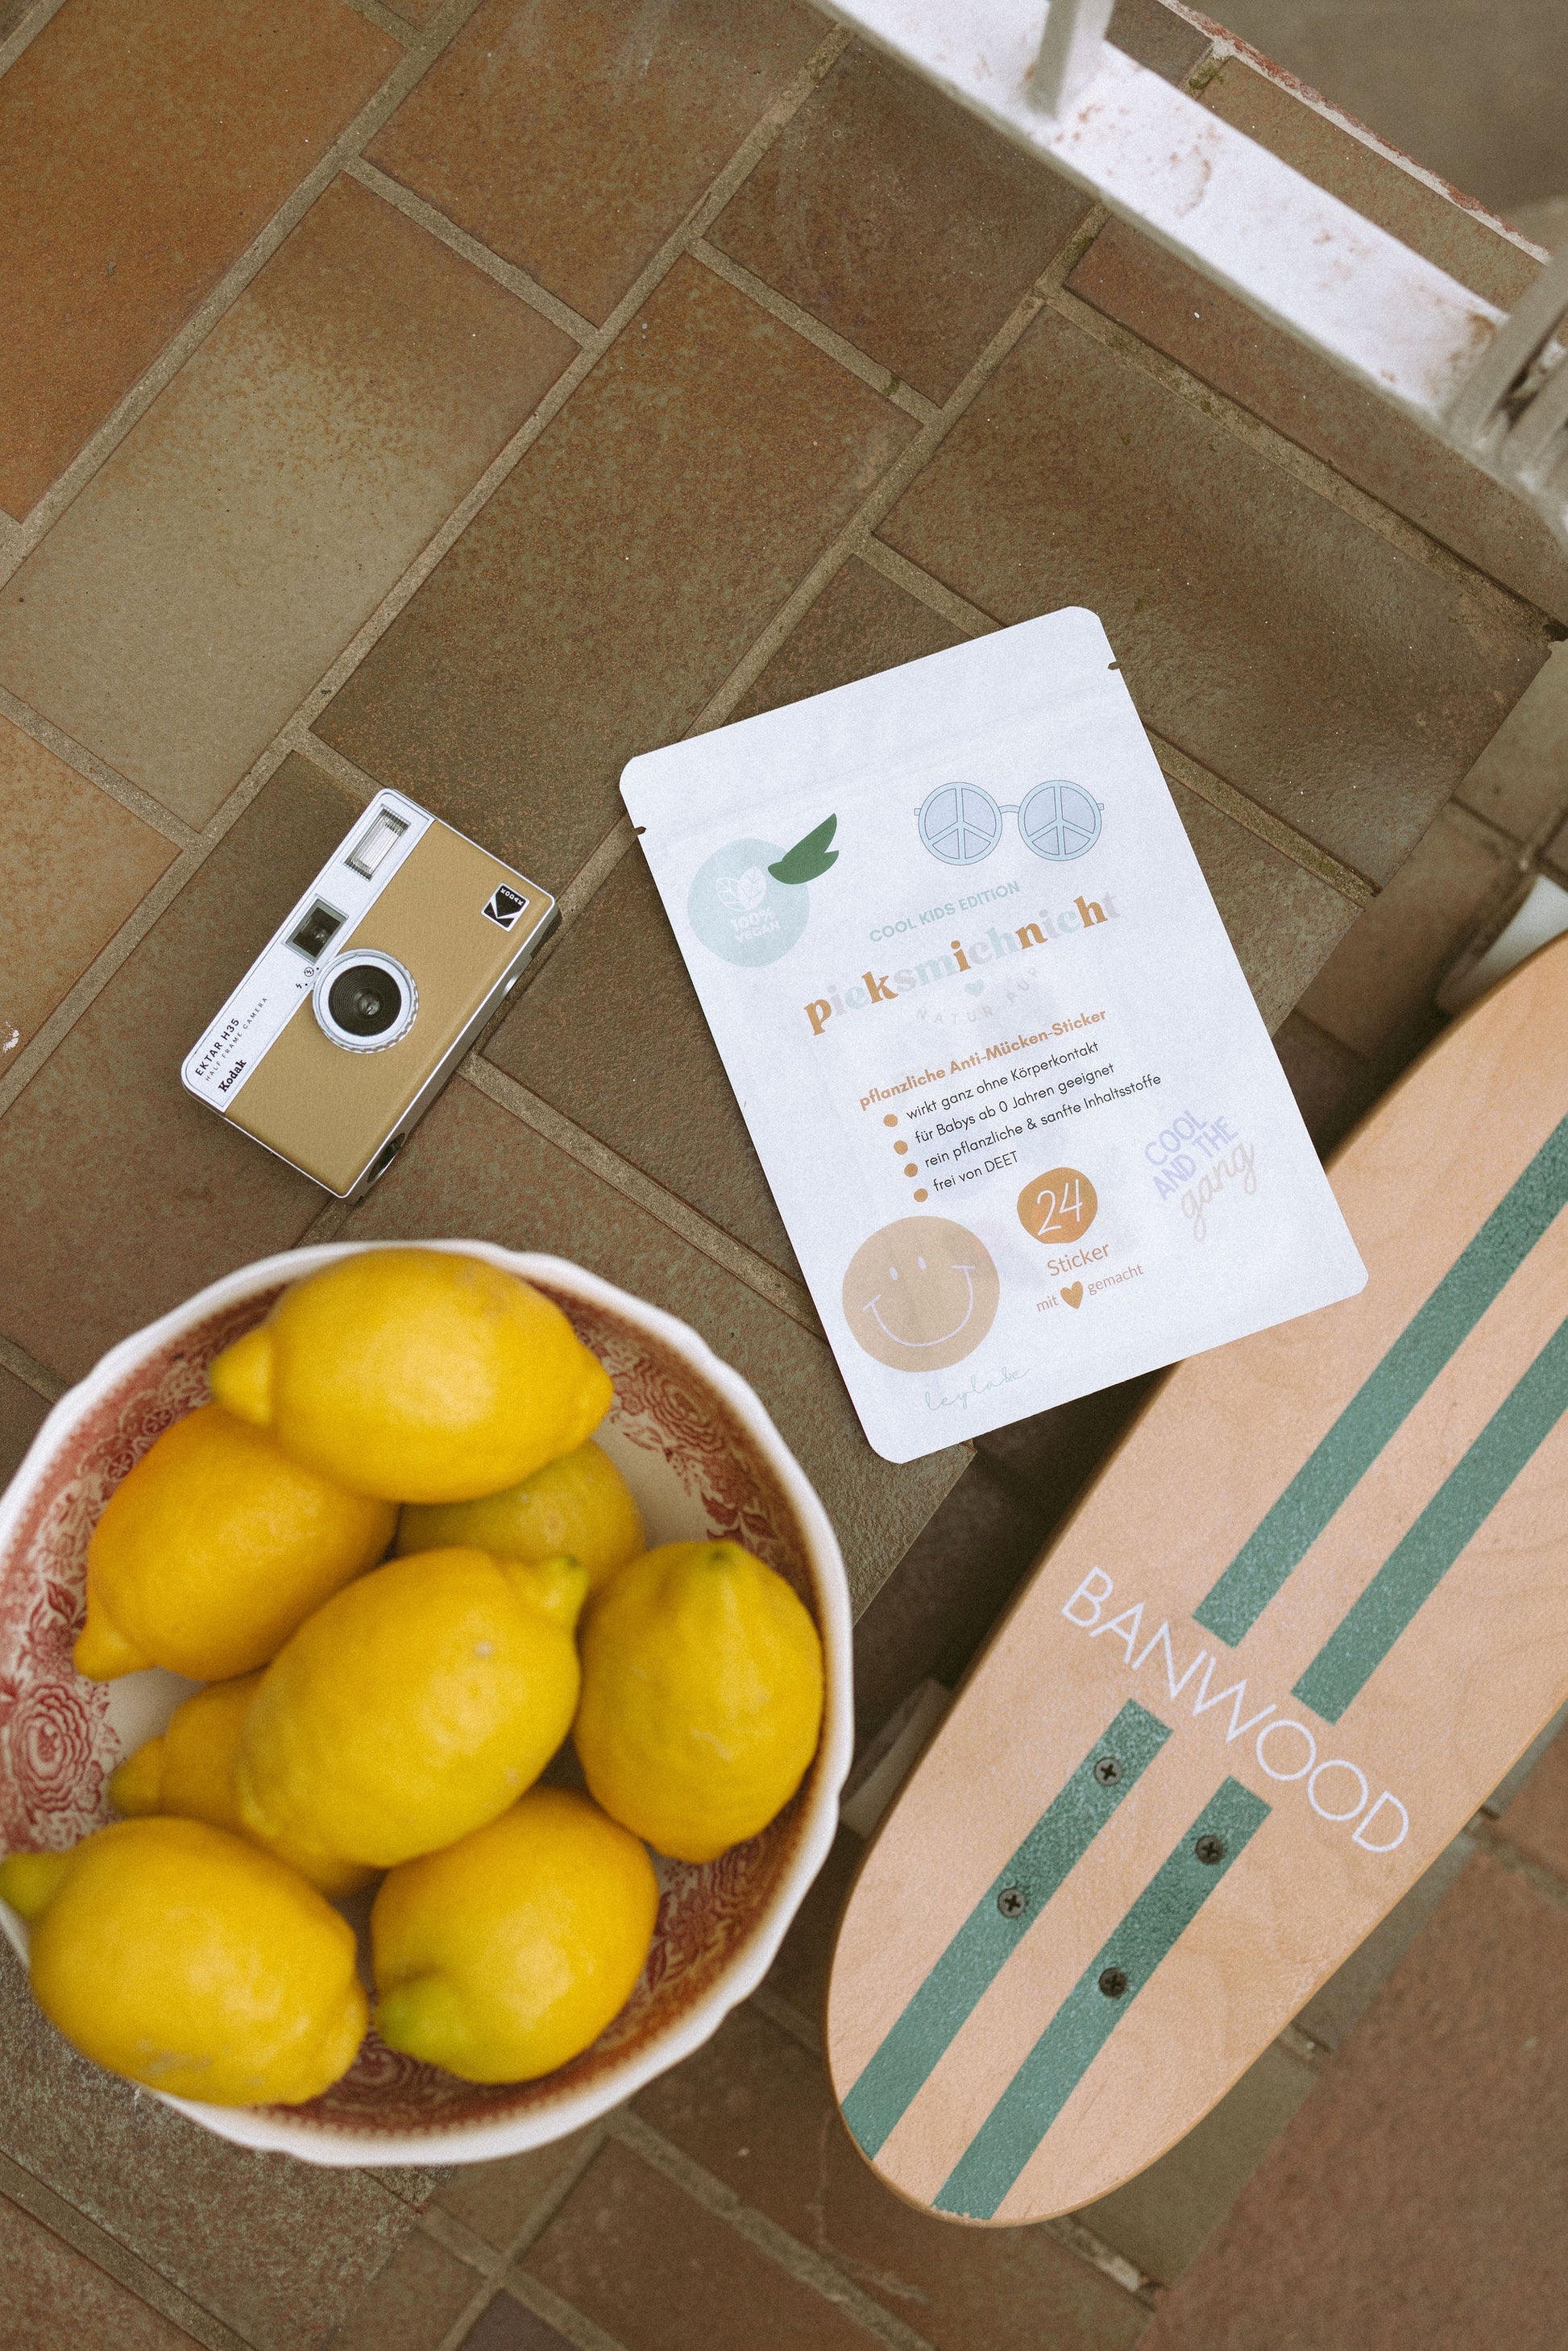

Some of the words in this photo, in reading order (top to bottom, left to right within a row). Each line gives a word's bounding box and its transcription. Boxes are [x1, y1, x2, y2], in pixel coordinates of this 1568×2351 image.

[500, 888, 524, 906] KODAK
[869, 918, 917, 942] COOL
[919, 902, 956, 926] KIDS
[958, 881, 1021, 910] EDITION
[734, 920, 780, 943] VEGAN
[804, 892, 1121, 1036] pieksmichnicht
[916, 1005, 993, 1025] NATUR
[1006, 967, 1039, 1004] PUR
[195, 1042, 223, 1076] EKTAR
[221, 1018, 239, 1040] H35
[205, 1061, 221, 1082] HALF
[222, 1032, 242, 1059] FRAME
[243, 997, 268, 1030] CAMERA
[859, 1068, 946, 1110] pflanzliche
[950, 1010, 1106, 1075] Anti-Mücken-Sticker
[218, 1059, 247, 1093] Kodak
[906, 1100, 937, 1120] wirkt
[942, 1089, 973, 1110] ganz
[977, 1076, 1008, 1094] ohne
[1010, 1041, 1099, 1080] Körperkontakt
[915, 1128, 934, 1144] für
[936, 1114, 976, 1137] Babys
[978, 1105, 996, 1122] ab
[999, 1101, 1008, 1113] 0
[1012, 1085, 1055, 1109] Jahren
[1058, 1063, 1114, 1095] geeignet
[925, 1151, 950, 1168] rein
[952, 1122, 1023, 1159] pflanzliche
[1027, 1117, 1038, 1130] &
[1041, 1102, 1081, 1126] sanfte
[1084, 1073, 1161, 1109] Inhaltsstoffe
[1144, 1109, 1208, 1166] COOL
[933, 1175, 956, 1192] frei
[959, 1167, 982, 1183] von
[985, 1151, 1018, 1173] DEET
[1153, 1154, 1197, 1200] AND
[1192, 1115, 1238, 1159] THE
[1036, 1179, 1083, 1236] 24
[1181, 1142, 1257, 1242] gang
[1036, 1296, 1059, 1312] mit
[1088, 1264, 1144, 1296] gemacht
[1047, 1244, 1109, 1276] Sticker
[1061, 1566, 1409, 1853] BANWOOD
